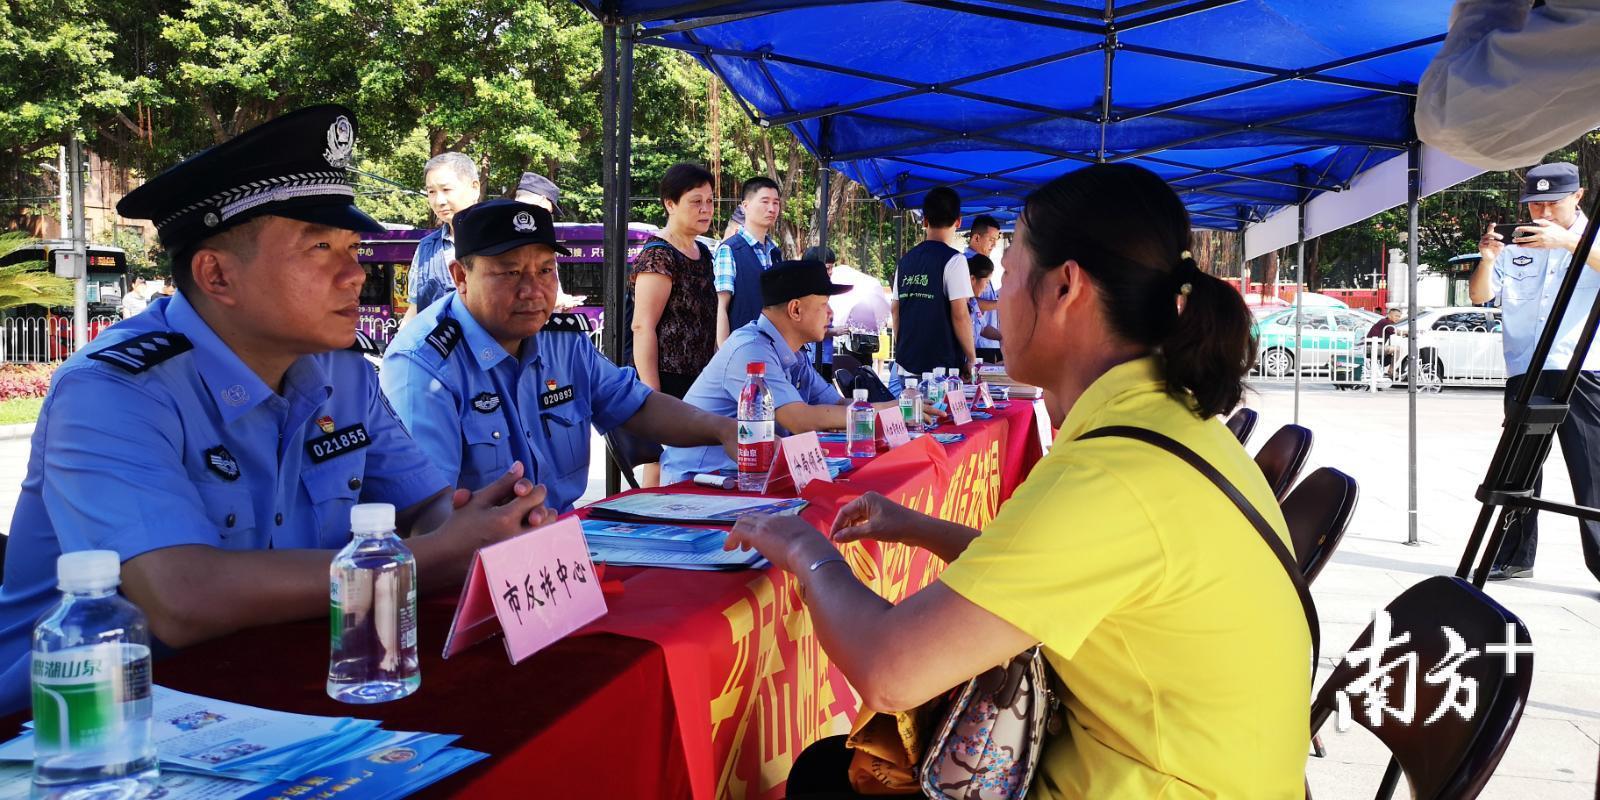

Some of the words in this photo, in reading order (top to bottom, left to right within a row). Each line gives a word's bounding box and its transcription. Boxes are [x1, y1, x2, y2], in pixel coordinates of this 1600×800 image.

[543, 388, 573, 406] 020893
[313, 428, 367, 458] 021855
[502, 558, 588, 626] 市反诈中心
